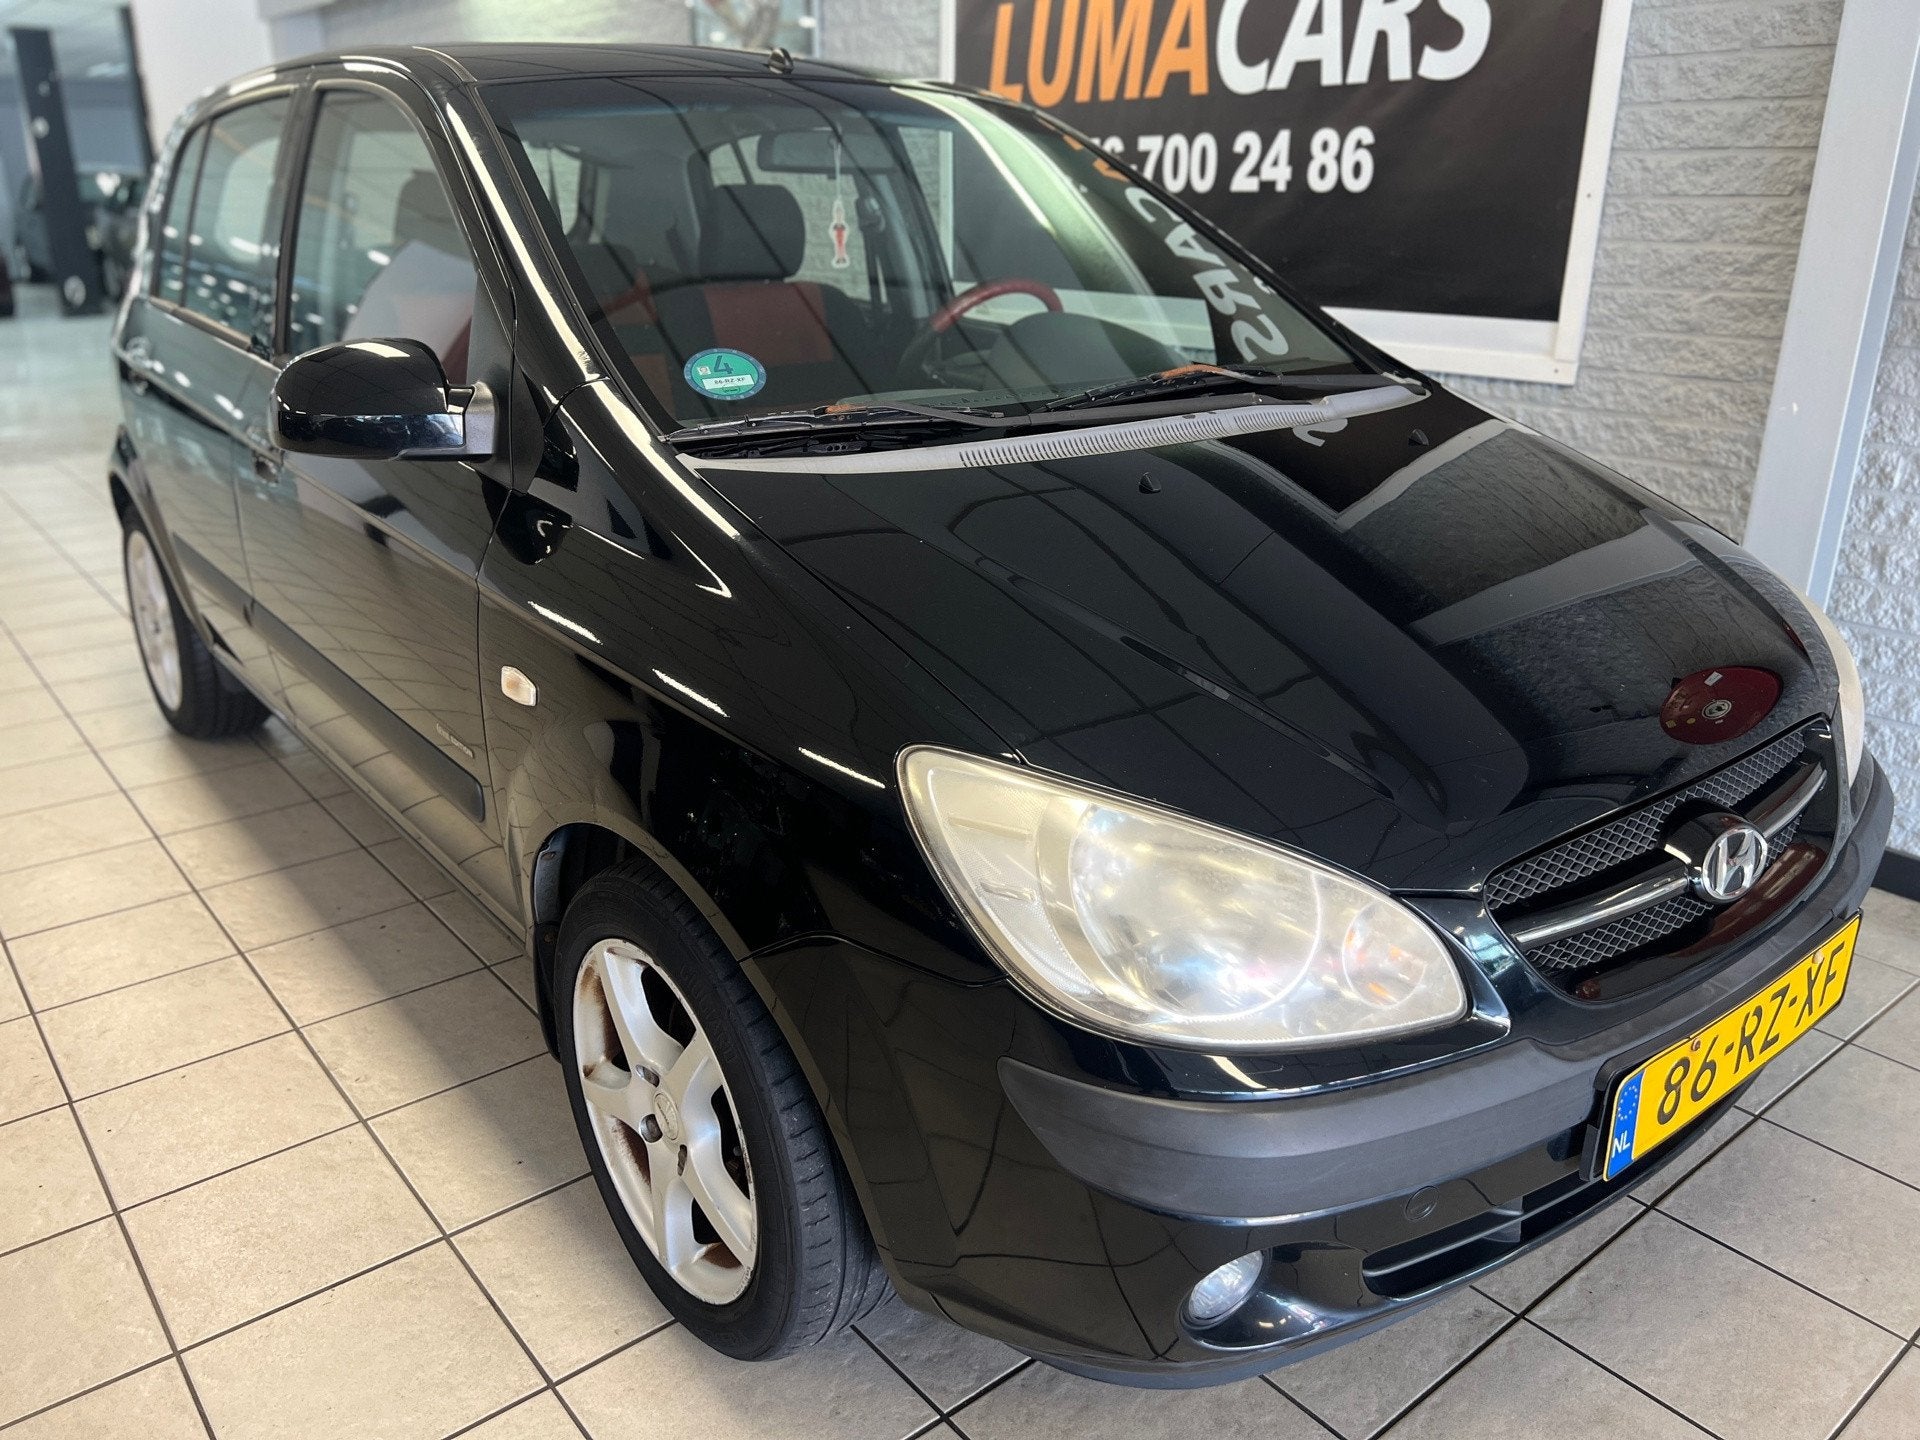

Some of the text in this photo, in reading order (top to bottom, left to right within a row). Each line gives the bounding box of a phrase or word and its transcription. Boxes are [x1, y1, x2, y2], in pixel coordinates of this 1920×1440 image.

[1229, 129, 1292, 192] 24
[1307, 125, 1376, 193] 86
[714, 355, 734, 375] 4
[1656, 940, 1846, 1126] 86-RZ-XF
[1611, 1130, 1631, 1158] NL
